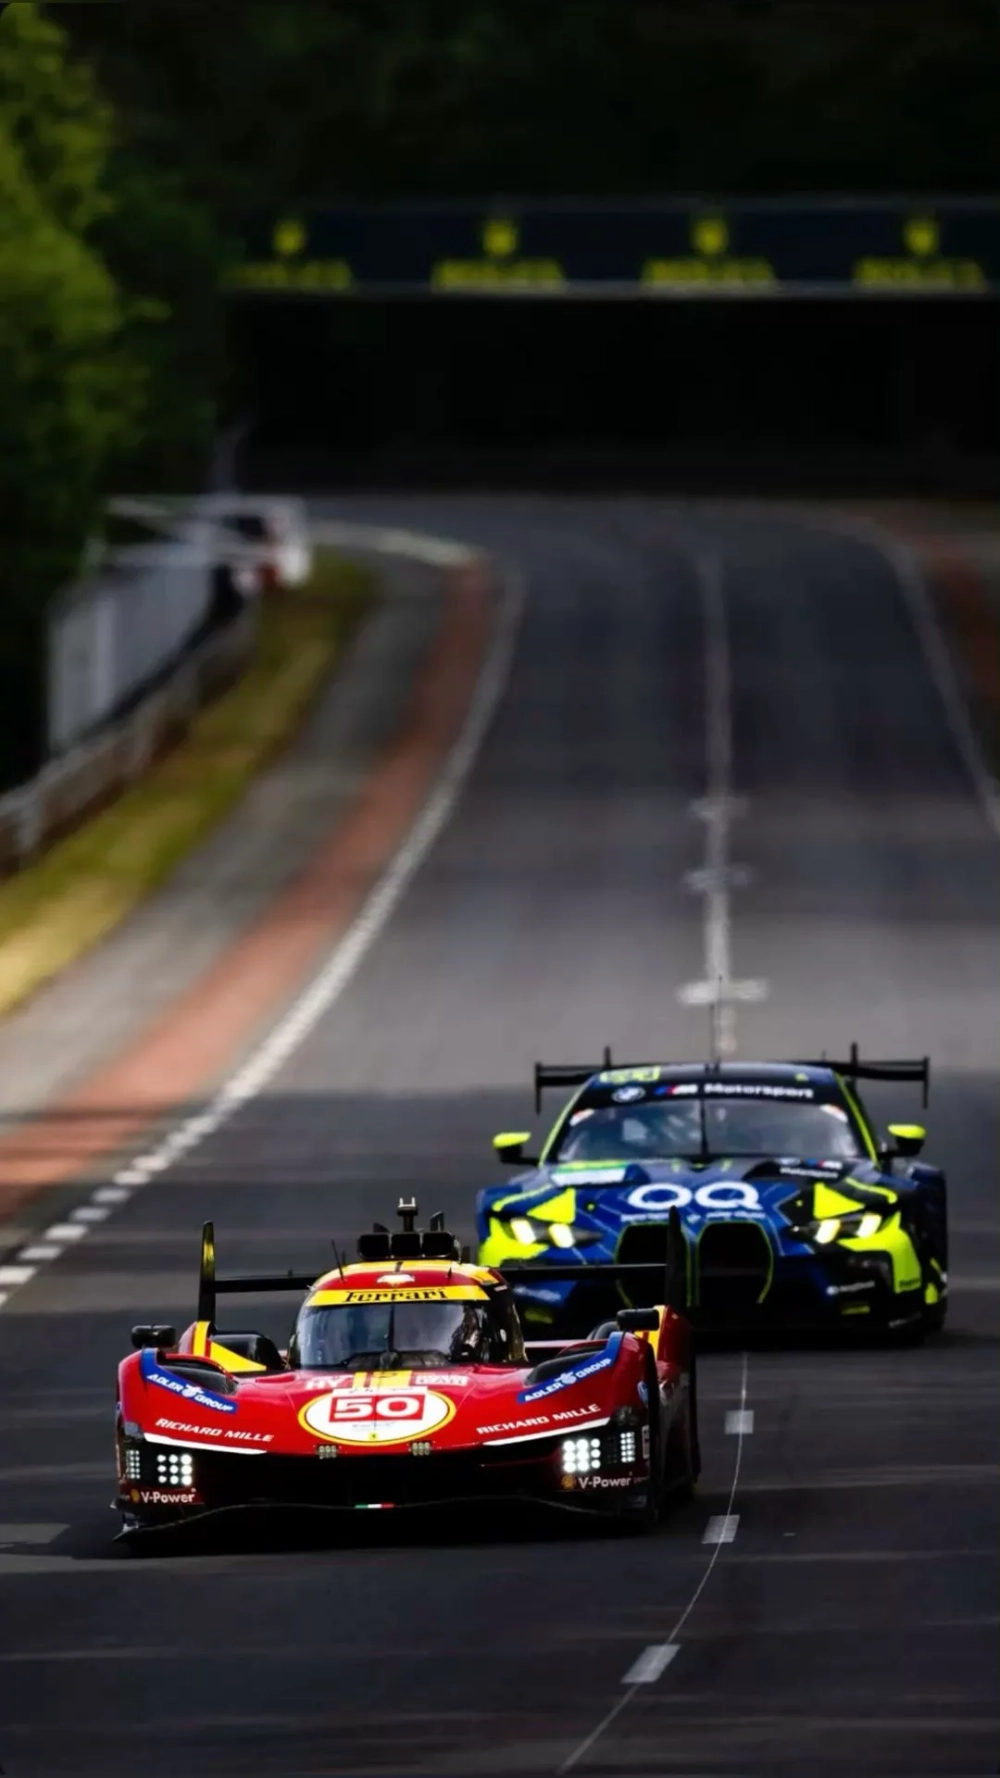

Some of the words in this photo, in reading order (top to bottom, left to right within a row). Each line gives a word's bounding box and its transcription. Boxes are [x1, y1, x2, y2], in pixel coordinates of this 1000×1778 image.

[704, 1083, 814, 1099] Motorsport
[627, 1181, 763, 1210] OQ
[344, 1288, 448, 1303] Ferrari
[525, 1382, 564, 1402] ADLER
[575, 1357, 612, 1379] GROUP
[145, 1373, 183, 1393] ADLER
[194, 1393, 235, 1412] GROUP
[333, 1396, 420, 1420] 50
[476, 1416, 550, 1435] RICHARD
[552, 1403, 601, 1421] MILLE
[154, 1417, 222, 1437] RICHARD
[224, 1429, 275, 1443] MILLE
[577, 1475, 632, 1489] V-Power
[140, 1490, 196, 1504] V-Power
